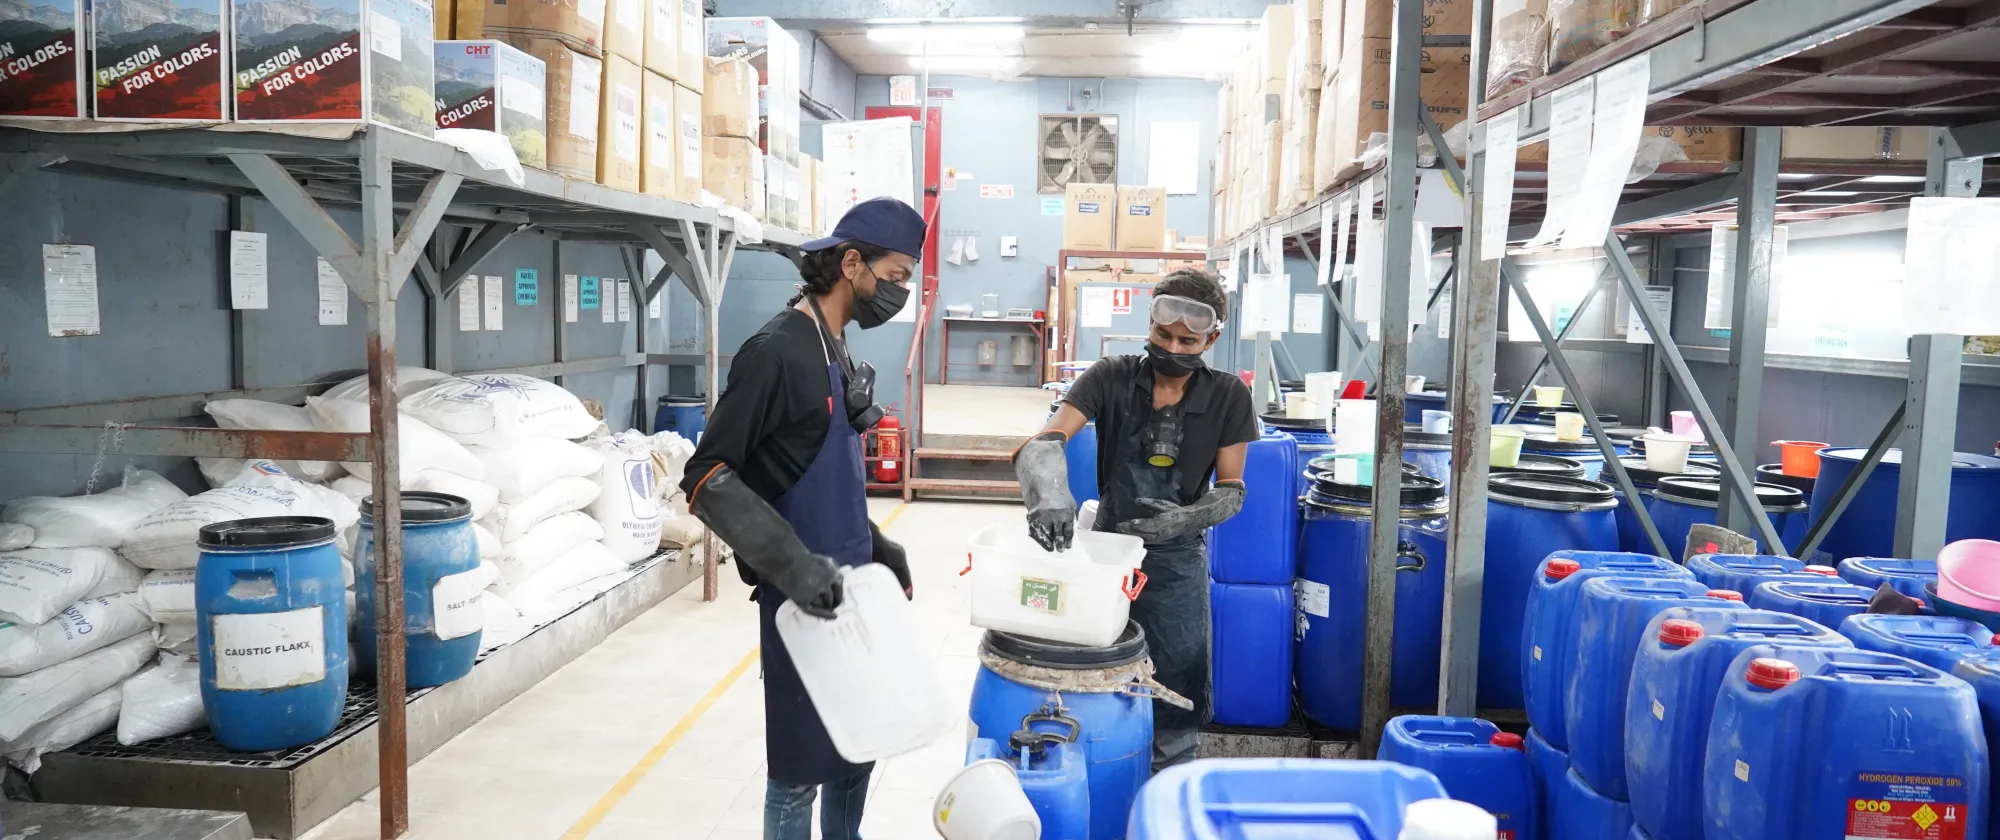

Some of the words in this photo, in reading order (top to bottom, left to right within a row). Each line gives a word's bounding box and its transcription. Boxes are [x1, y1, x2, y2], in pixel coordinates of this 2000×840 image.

[8, 40, 73, 76] COLORS.
[100, 44, 162, 86] PASSION
[239, 45, 302, 87] PASSION
[466, 45, 490, 55] CHT
[123, 70, 154, 95] FOR
[154, 42, 218, 79] COLORS.
[263, 71, 295, 96] FOR
[294, 42, 358, 80] COLORS.
[441, 95, 493, 127] COLORS.
[894, 88, 912, 102] EXIT
[447, 600, 466, 611] SALT
[225, 646, 272, 657] CAUSTIC
[1859, 773, 1902, 783] HYDROGEN
[1905, 775, 1944, 786] PEROXIDE
[1946, 777, 1962, 787] 50%
